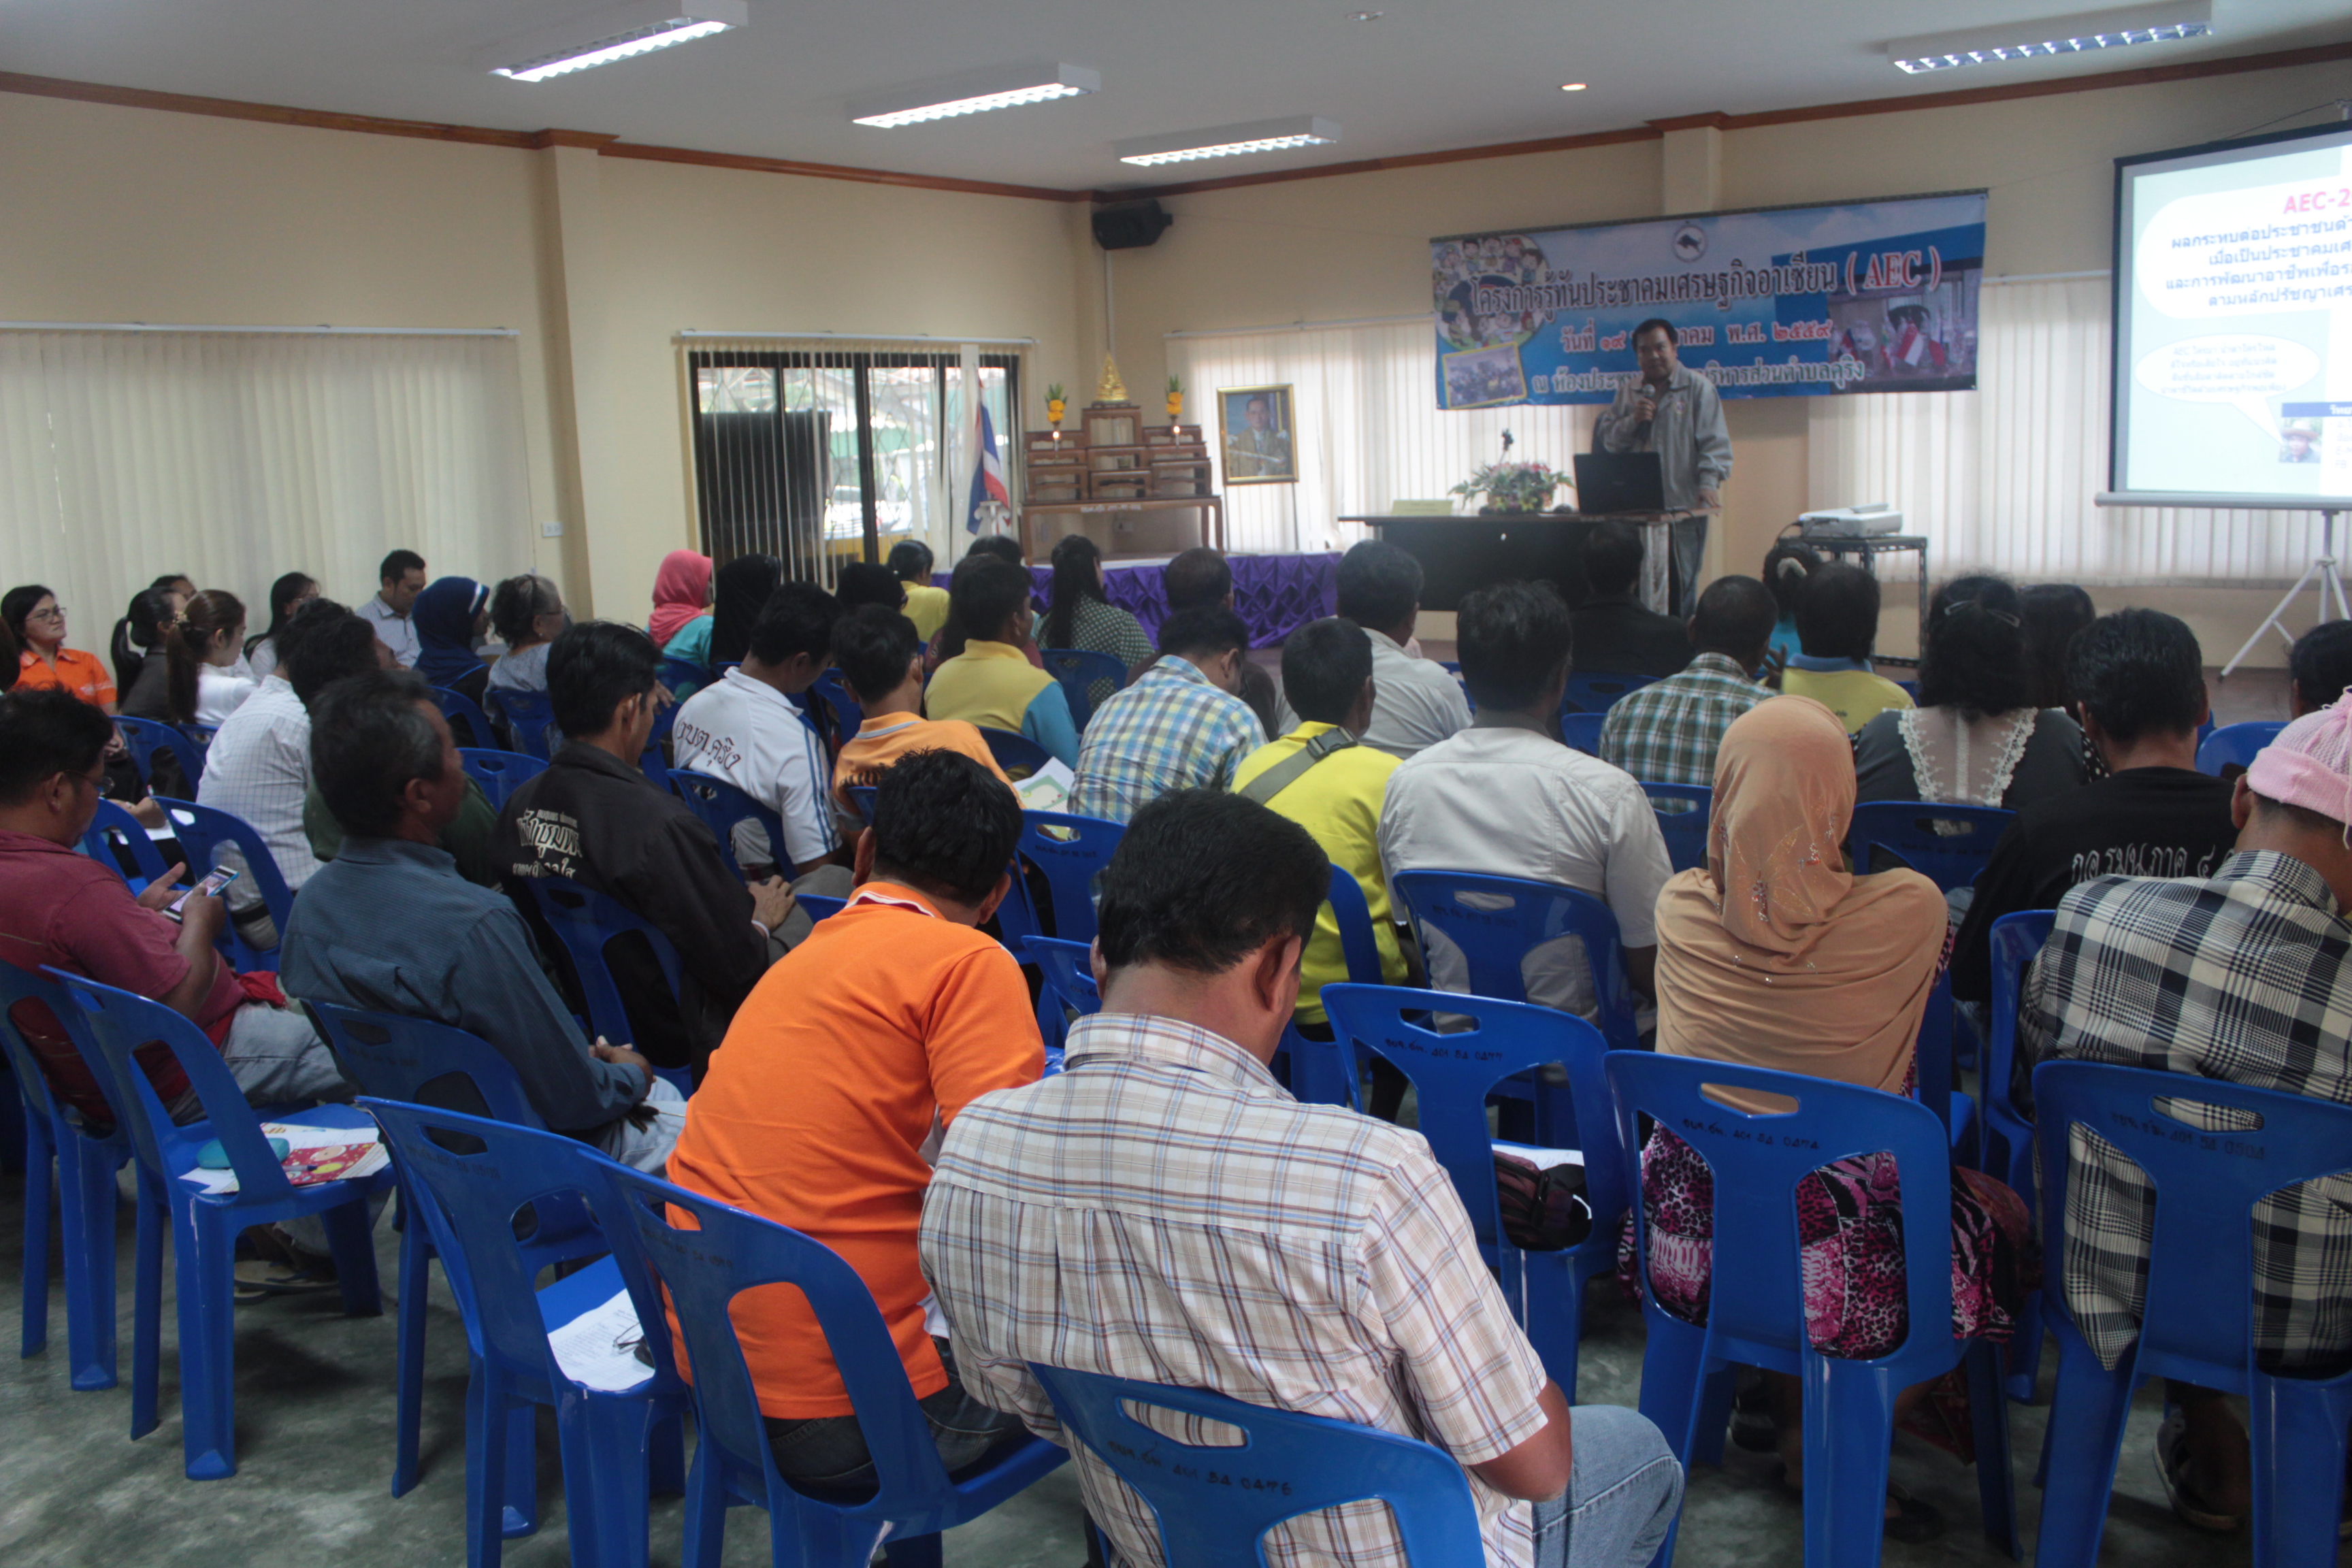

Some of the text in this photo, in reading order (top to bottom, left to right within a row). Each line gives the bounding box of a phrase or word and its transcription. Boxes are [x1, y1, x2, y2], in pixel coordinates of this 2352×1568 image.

[2283, 188, 2352, 214] AEC-2
[1470, 250, 1836, 321] โครงการรู้ทันประชาคมเศรษฐกิจอาเซียน
[2166, 259, 2352, 289] และการพัฒนาอาชีพเพื่อร
[1561, 318, 1595, 352] วันที่
[1727, 322, 1767, 344] พ.ศ.
[1772, 319, 1833, 341] ๒๕๕๙
[1532, 374, 1549, 393] ณ
[1697, 355, 1865, 390] ริหารส่วนตำบลคุริง
